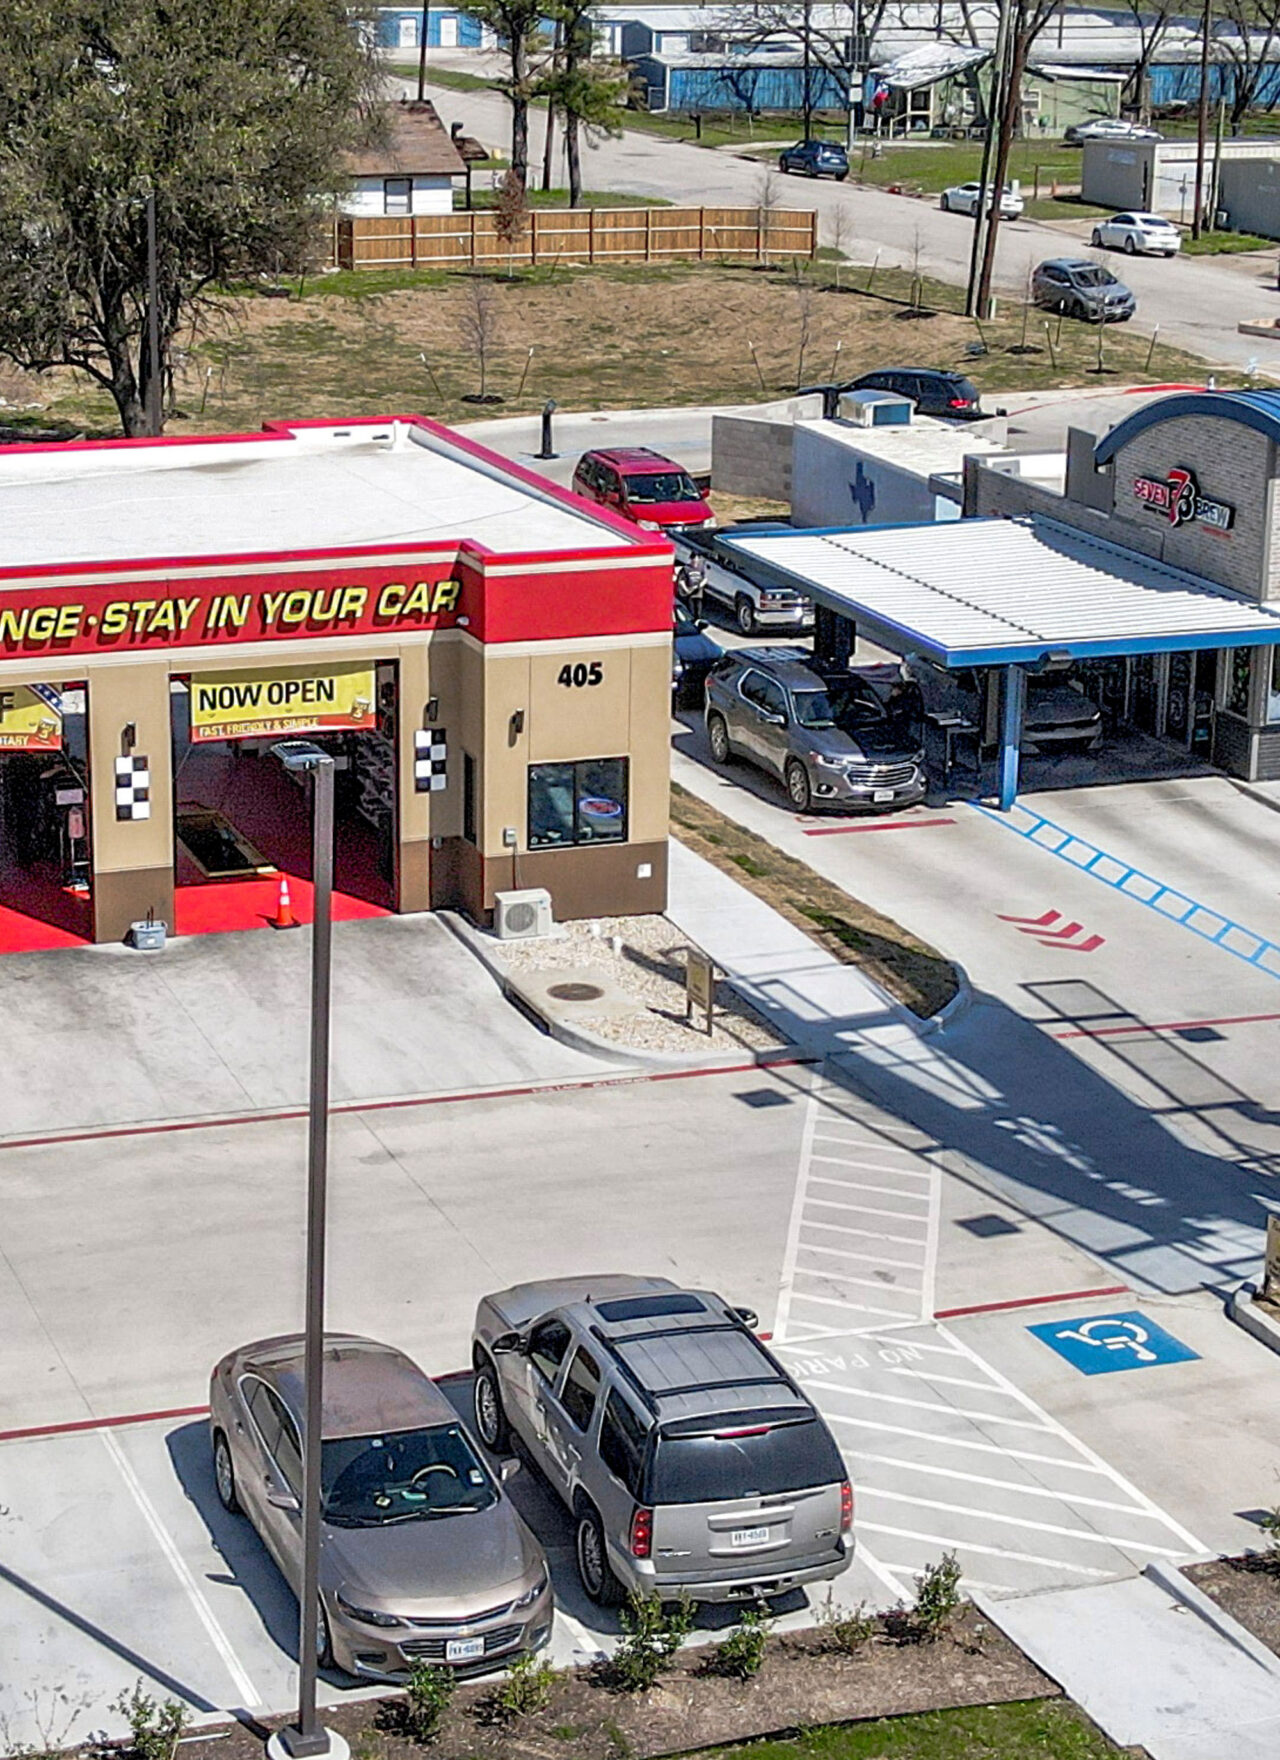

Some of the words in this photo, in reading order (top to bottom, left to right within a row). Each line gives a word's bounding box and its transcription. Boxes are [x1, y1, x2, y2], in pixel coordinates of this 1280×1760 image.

[1133, 478, 1169, 508] SEVEN
[1195, 497, 1230, 530] BREW
[101, 596, 200, 635] STAY
[207, 594, 252, 628] IN
[263, 586, 369, 624] YOUR
[377, 580, 460, 616] CAR
[557, 661, 603, 688] 405
[199, 683, 263, 711] NOW
[267, 679, 334, 706] OPEN
[878, 1346, 924, 1364] NO
